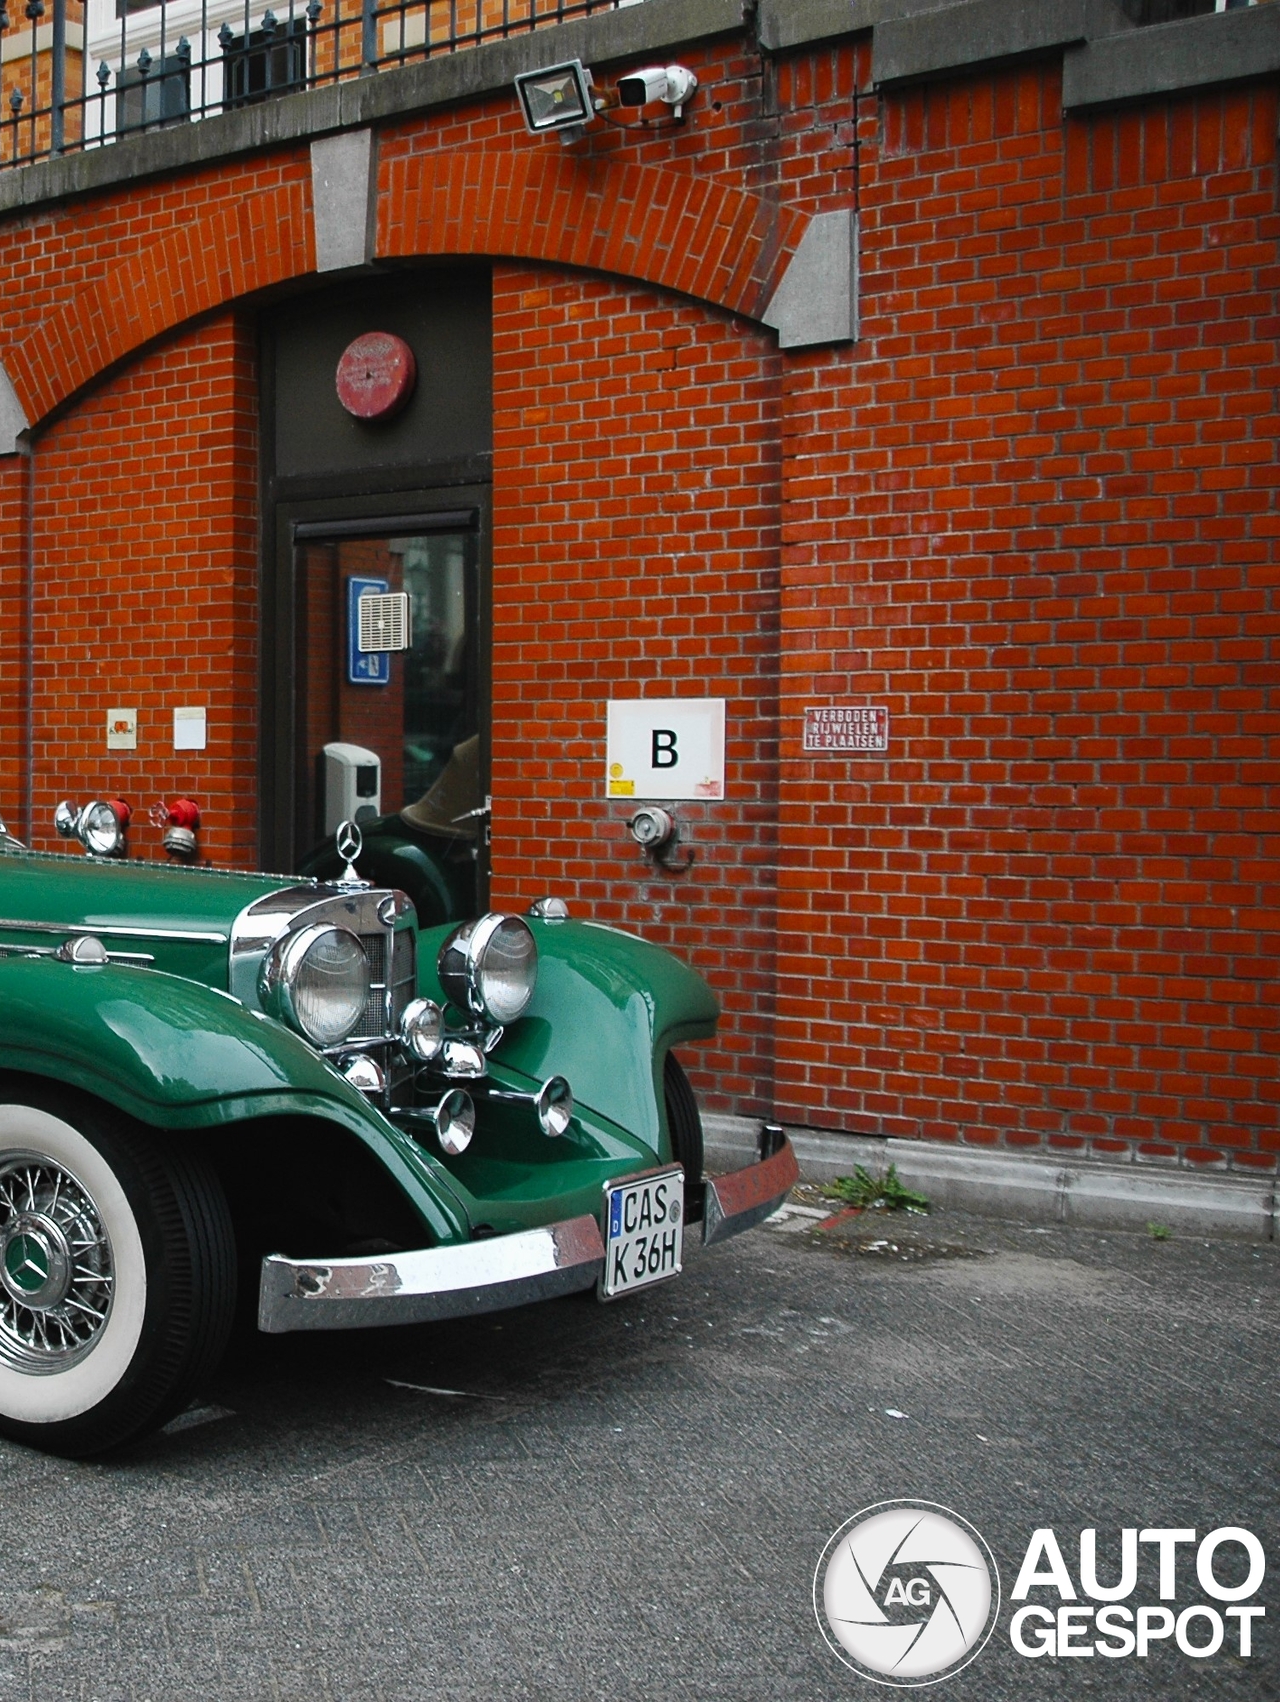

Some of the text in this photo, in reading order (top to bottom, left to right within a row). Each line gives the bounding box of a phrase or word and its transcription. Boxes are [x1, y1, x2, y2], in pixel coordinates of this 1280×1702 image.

[814, 710, 877, 722] VERBODEN
[812, 722, 878, 735] RIJWIELEN
[808, 735, 883, 748] TE PLAATSEN
[651, 729, 679, 769] B
[624, 1183, 667, 1234] CAS
[612, 1220, 619, 1233] D
[614, 1228, 677, 1286] K 36H
